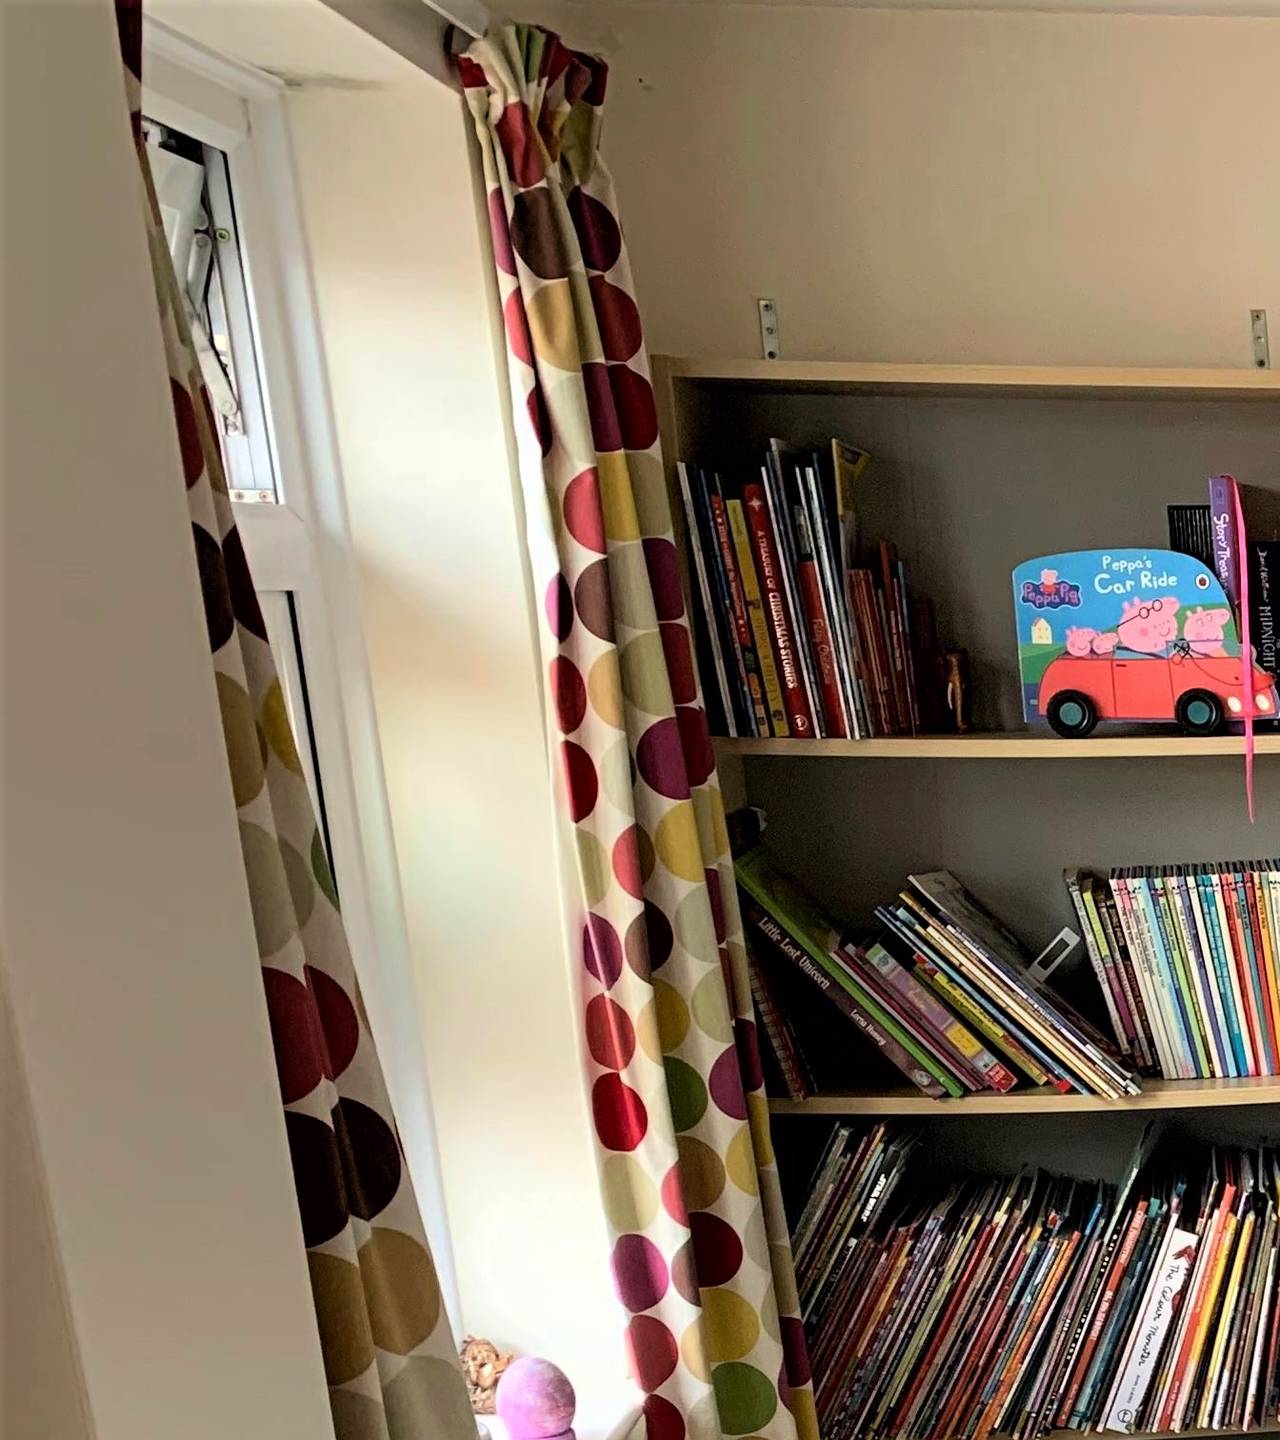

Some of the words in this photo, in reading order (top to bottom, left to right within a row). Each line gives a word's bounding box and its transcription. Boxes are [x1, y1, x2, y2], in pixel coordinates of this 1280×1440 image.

[1213, 512, 1230, 548] Story
[1102, 555, 1153, 573] Peppa's
[1094, 572, 1135, 595] Car
[1140, 570, 1178, 589] Ride
[768, 590, 789, 648] CHRISTMAS
[779, 647, 797, 689] STORIES
[1259, 605, 1275, 668] MIDNIGHT
[757, 916, 784, 942] Little
[779, 937, 801, 959] Lost
[797, 955, 831, 990] Unicorn
[870, 1172, 888, 1199] STAR
[859, 1196, 876, 1222] WARS
[1166, 1263, 1179, 1281] The
[1152, 1284, 1172, 1323] Colour
[1137, 1324, 1158, 1368] Monster
